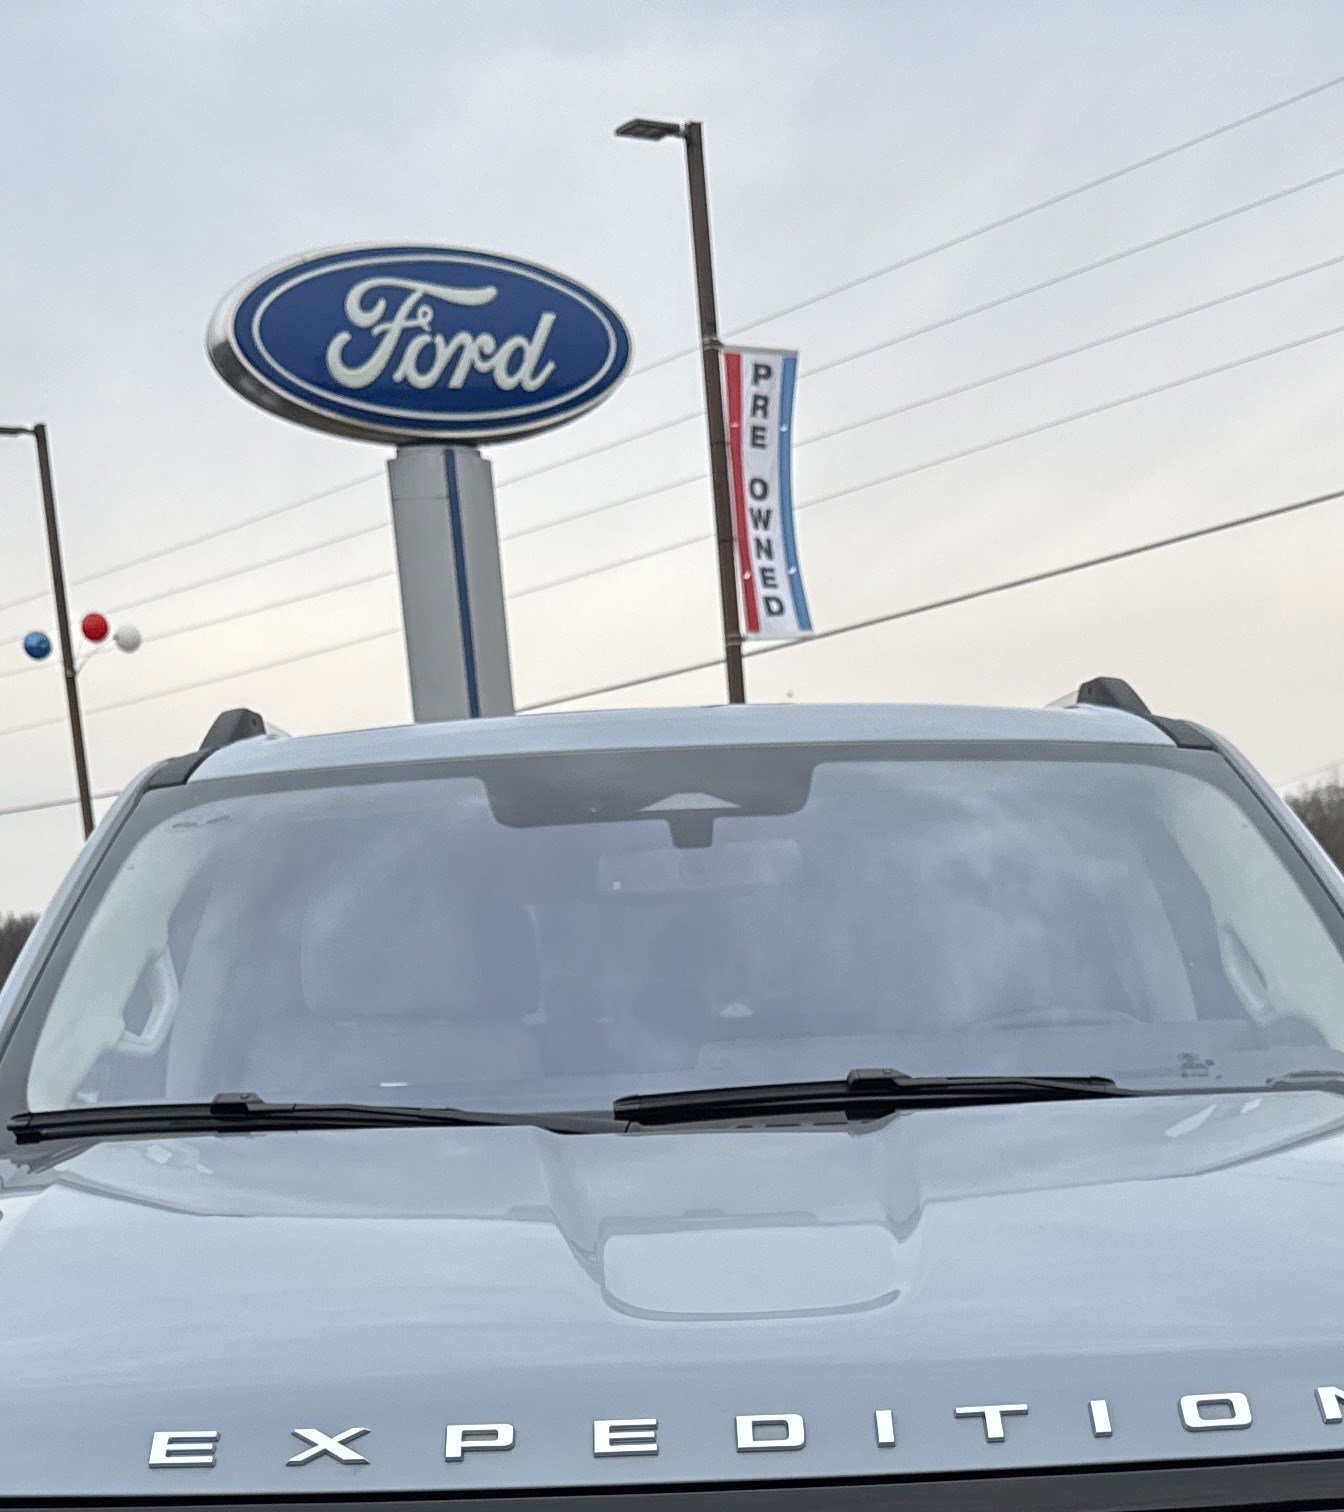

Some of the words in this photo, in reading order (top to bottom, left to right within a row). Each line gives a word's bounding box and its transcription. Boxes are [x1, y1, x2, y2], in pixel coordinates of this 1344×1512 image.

[325, 277, 556, 392] Ford
[750, 362, 773, 449] PRE
[749, 477, 786, 617] OWNED
